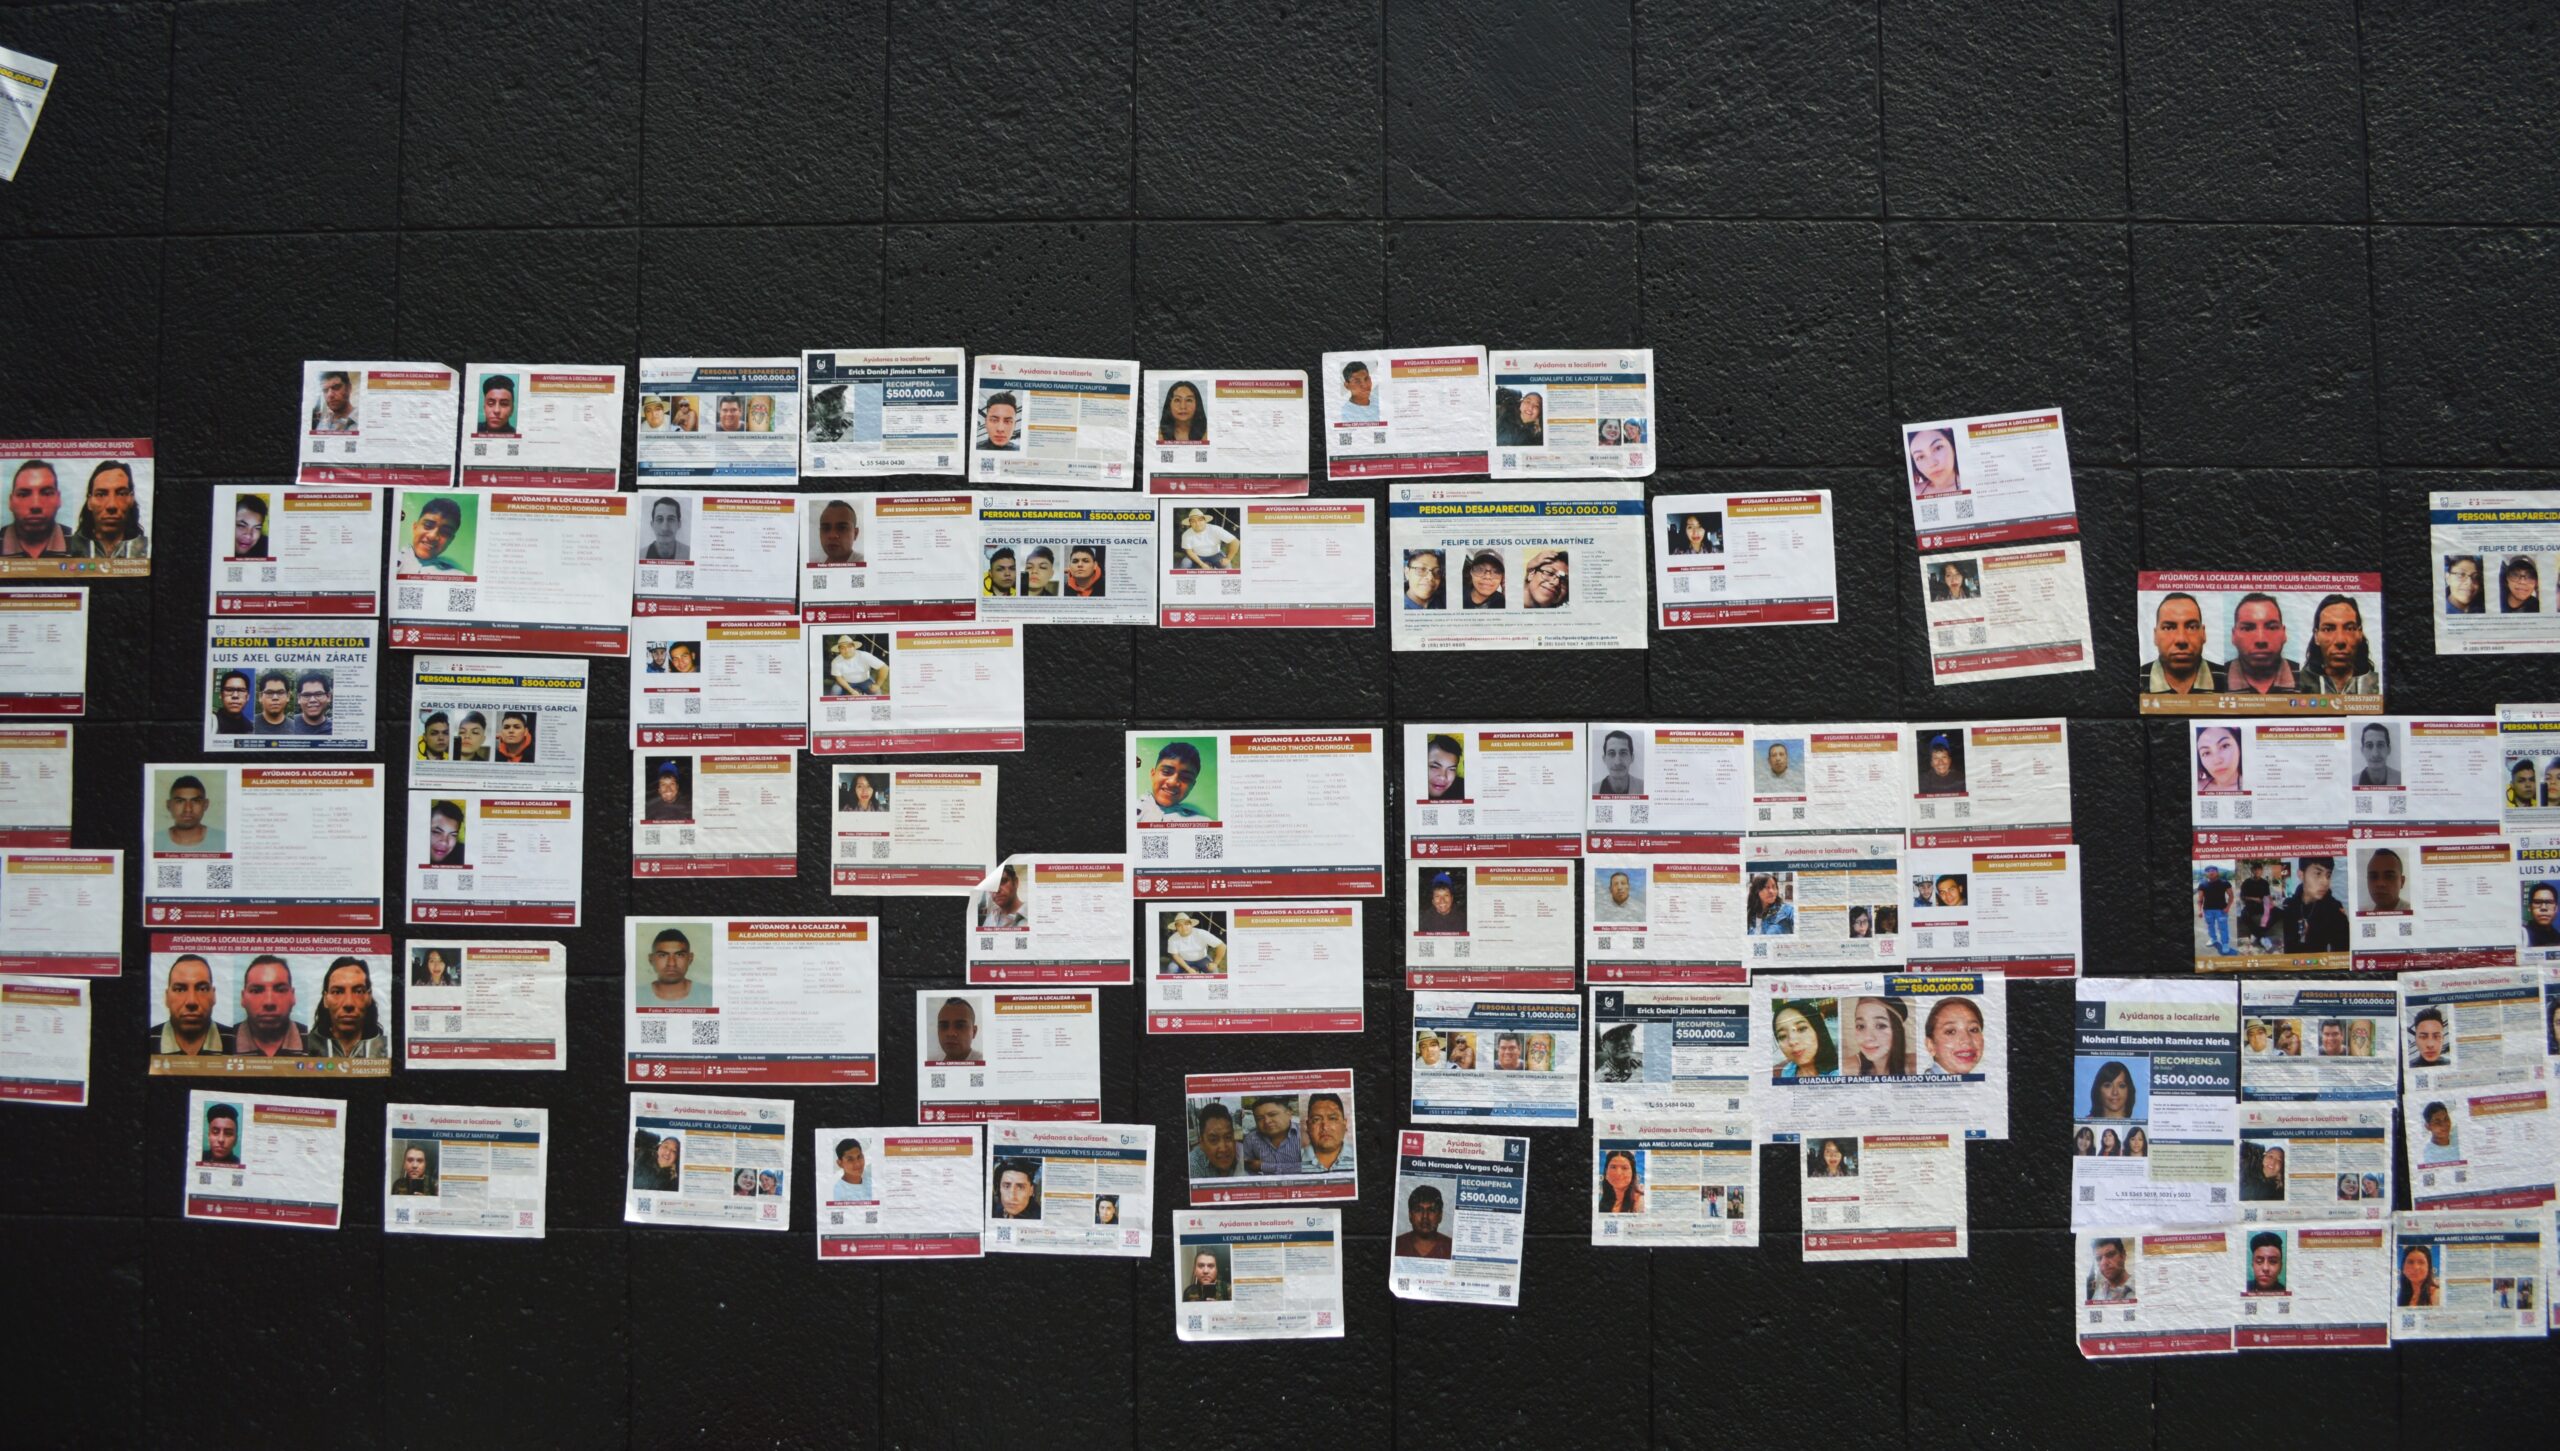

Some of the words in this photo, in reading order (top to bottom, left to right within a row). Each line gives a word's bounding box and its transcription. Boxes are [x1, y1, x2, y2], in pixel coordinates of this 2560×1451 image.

[848, 367, 865, 376] Erick
[866, 367, 888, 376] Daniel
[889, 367, 916, 376] Jiménez
[916, 367, 946, 376] Ramírez
[886, 389, 945, 399] $500,000.00
[558, 496, 599, 505] LOCALIZAR
[507, 503, 545, 511] FRANCISCO
[1419, 505, 1463, 514] PERSONA
[1464, 504, 1536, 514] DESAPARECIDA
[982, 510, 1020, 519] PERSONA
[1021, 510, 1082, 519] DESAPARECIDA
[2457, 512, 2497, 521] PERSONA
[985, 536, 1021, 545] CARLOS
[1022, 536, 1068, 545] EDUARDO
[1069, 537, 1111, 545] FUENTES
[1113, 537, 1148, 545] GARCÍA
[1441, 538, 1470, 546] FELIPE
[1471, 538, 1484, 546] DE
[1485, 538, 1512, 546] JESÚS
[1514, 537, 1548, 546] OLVERA
[1550, 537, 1594, 546] MARTÍNEZ
[2199, 573, 2205, 582] A
[2206, 573, 2244, 582] LOCALIZAR
[2244, 574, 2250, 582] A
[2251, 574, 2283, 582] RICARDO
[2284, 574, 2299, 582] LUIS
[2300, 574, 2330, 583] MÉNDEZ
[2331, 574, 2359, 583] BUSTOS
[216, 638, 269, 647] PERSONA
[276, 638, 364, 647] DESAPARECIDA
[212, 652, 238, 663] LUIS
[243, 652, 270, 663] AXEL
[274, 652, 321, 663] GUZMÁN
[326, 652, 368, 663] ZÁRATE
[419, 675, 455, 684] PERSONA
[456, 676, 514, 685] DESAPARECIDA
[420, 701, 455, 710] CARLOS
[456, 702, 500, 711] EDUARDO
[502, 703, 542, 712] FUENTES
[544, 704, 578, 713] GARCÍA
[211, 935, 217, 944] A
[218, 936, 255, 944] LOCALIZAR
[256, 936, 262, 944] A
[262, 936, 294, 944] RICARDO
[295, 936, 311, 945] LUIS
[311, 936, 341, 945] MÉNDEZ
[342, 937, 370, 945] BUSTOS
[1911, 982, 1974, 993] $500,000.00
[1476, 1003, 1515, 1012] PERSONAS
[1516, 1004, 1576, 1013] DESAPARECIDAS
[1637, 1006, 1654, 1015] Erick
[1655, 1006, 1678, 1015] Daniel
[1679, 1006, 1706, 1016] Jiménez
[1707, 1006, 1736, 1016] Ramírez
[1520, 1011, 1525, 1019] $
[2173, 1011, 2220, 1021] localizarle
[1675, 1020, 1726, 1028] RECOMPENSA
[1675, 1029, 1736, 1040] $500,000.00
[2082, 1035, 2118, 1045] Nohemí
[2119, 1035, 2163, 1046] Elizabeth
[2164, 1036, 2203, 1046] Ramírez
[2204, 1037, 2230, 1047] Neria
[2154, 1056, 2221, 1066] RECOMPENSA
[1798, 1076, 1846, 1085] GUADALUPE
[1847, 1075, 1879, 1084] PAMELA
[1880, 1074, 1924, 1083] GALLARDO
[1924, 1074, 1963, 1083] VOLANTE
[2153, 1074, 2230, 1086] $500,000.00
[1447, 1146, 1486, 1155] localizarle
[1411, 1159, 1426, 1169] Olin
[1427, 1160, 1463, 1171] Hernando
[1464, 1162, 1491, 1173] Vargas
[1491, 1163, 1514, 1174] Ojeda
[1460, 1178, 1513, 1189] RECOMPENSA
[1459, 1191, 1519, 1206] $500,000.00
